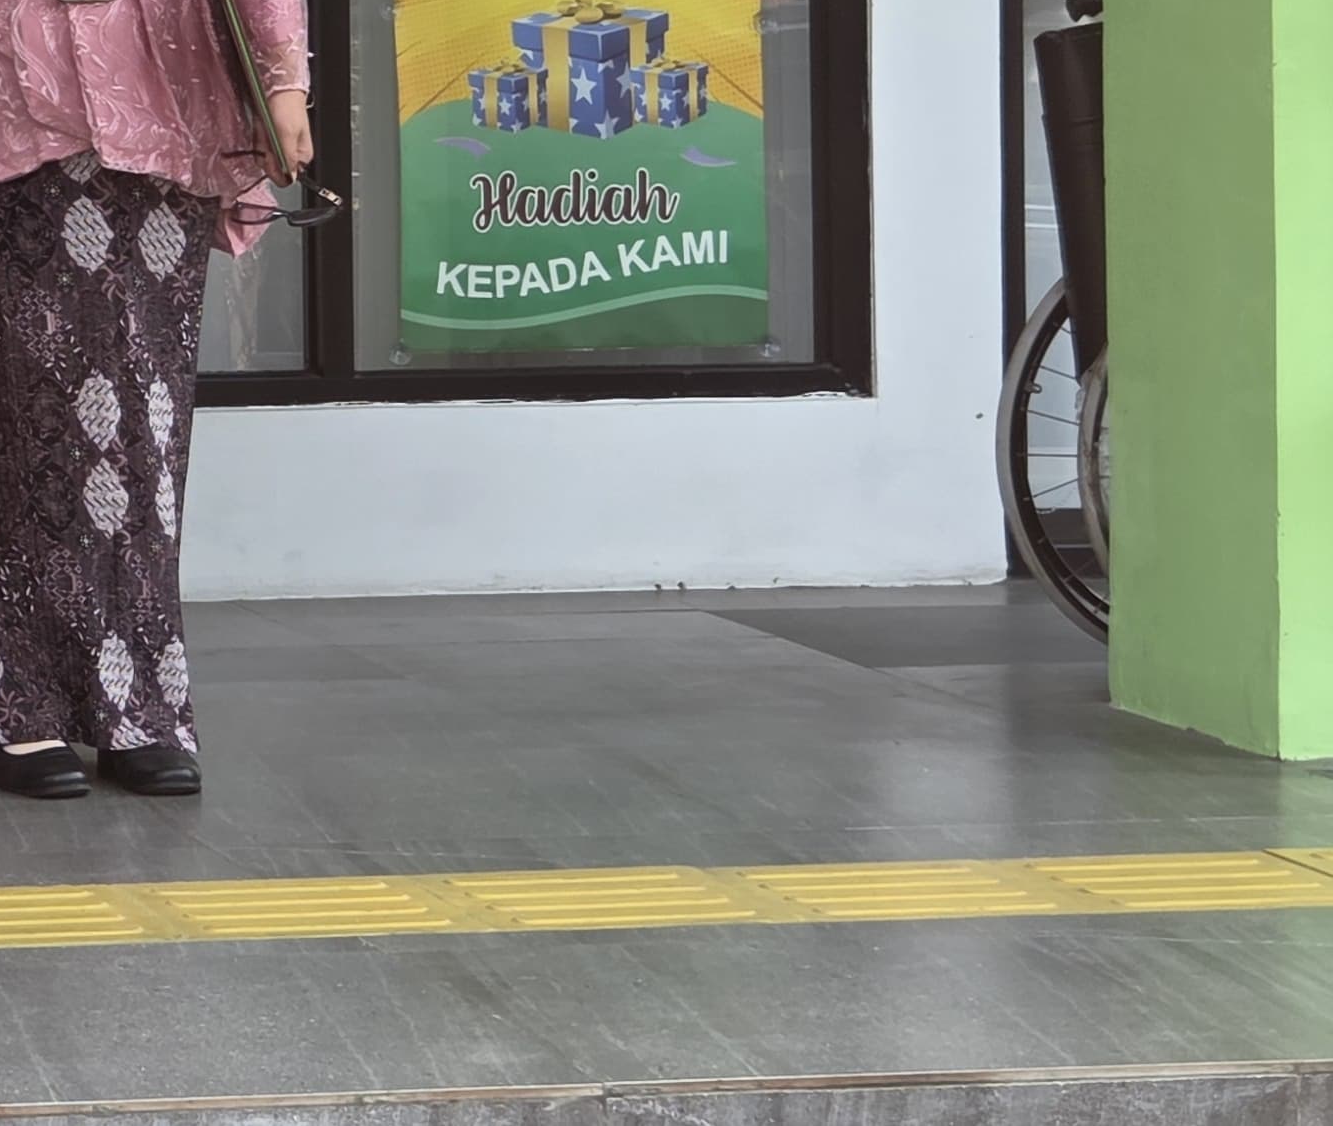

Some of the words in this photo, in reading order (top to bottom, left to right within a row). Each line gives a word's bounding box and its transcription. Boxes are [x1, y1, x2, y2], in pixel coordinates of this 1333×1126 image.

[471, 169, 679, 231] Hadiah
[437, 251, 612, 299] KEPADA
[617, 230, 728, 277] KAMI
